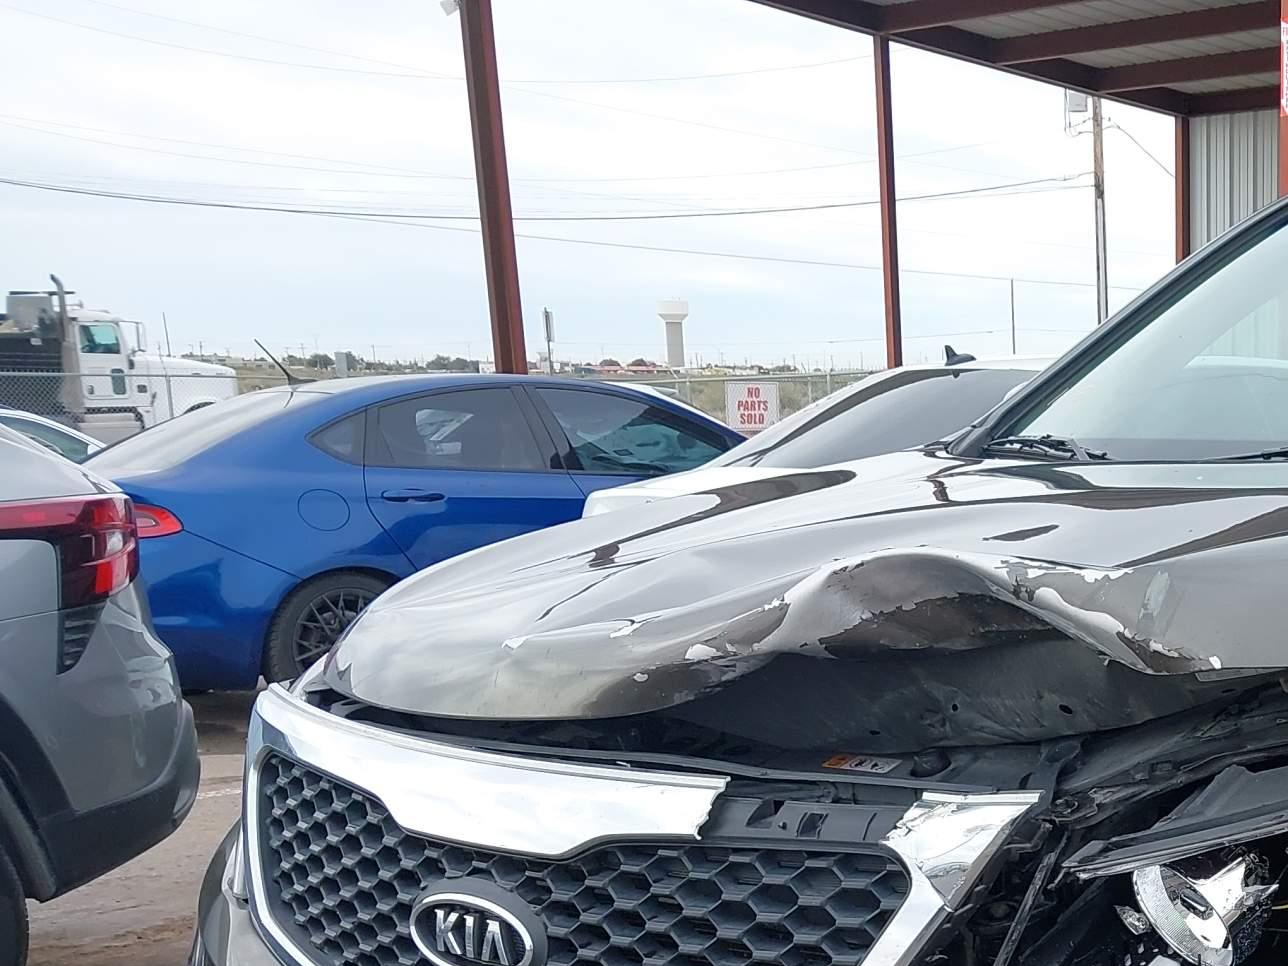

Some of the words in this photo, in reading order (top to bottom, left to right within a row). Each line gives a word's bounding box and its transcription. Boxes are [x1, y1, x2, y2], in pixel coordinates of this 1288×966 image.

[747, 386, 760, 399] NO
[737, 400, 769, 412] PARTS
[740, 412, 765, 425] SOLD
[434, 908, 510, 966] KIA
